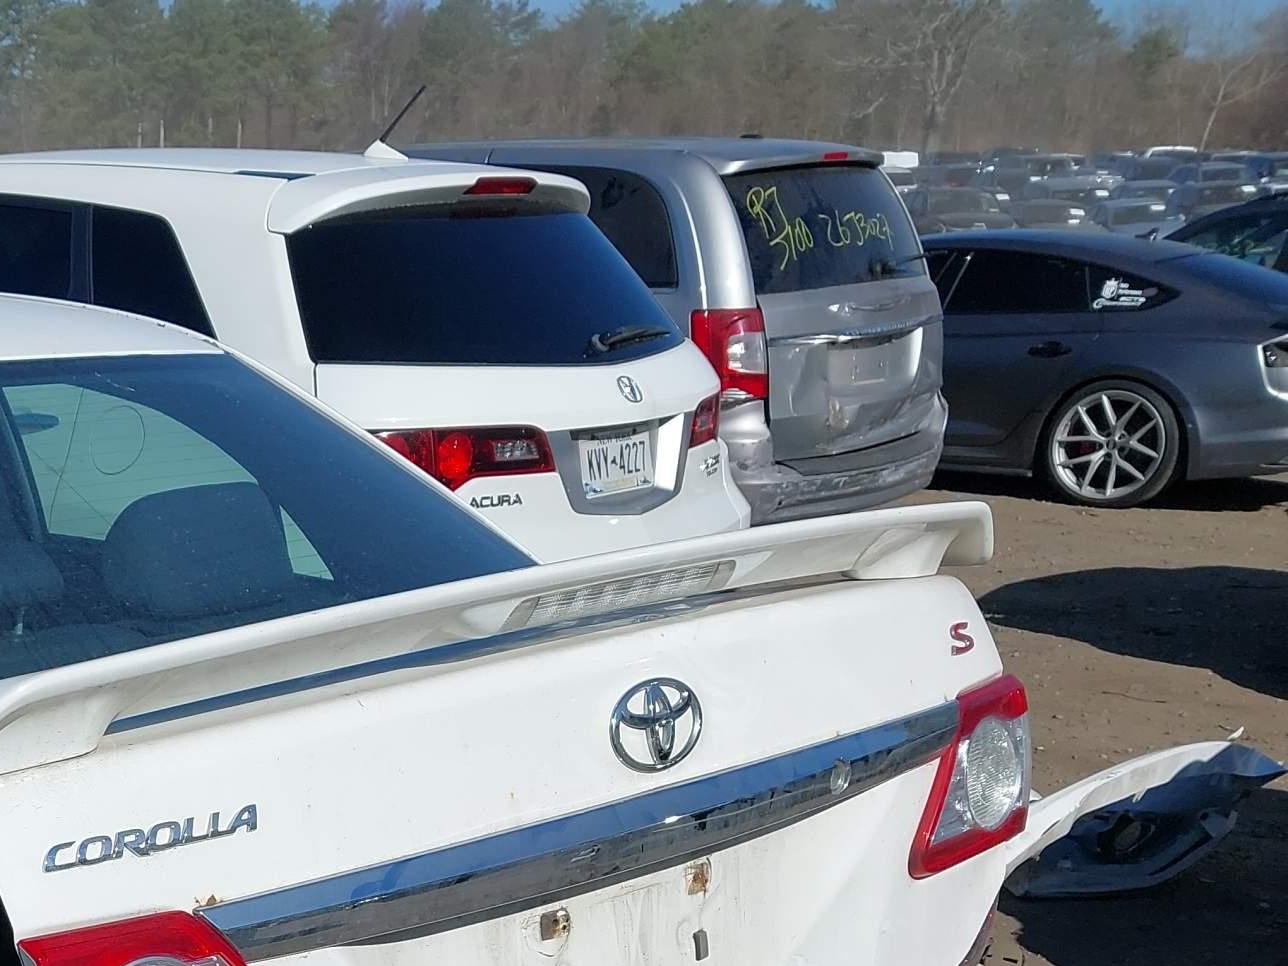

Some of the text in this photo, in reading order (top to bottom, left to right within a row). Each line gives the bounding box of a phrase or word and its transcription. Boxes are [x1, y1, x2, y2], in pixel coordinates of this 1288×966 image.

[470, 493, 523, 508] ACURA
[949, 621, 975, 656] S
[42, 803, 258, 873] COROLLA
